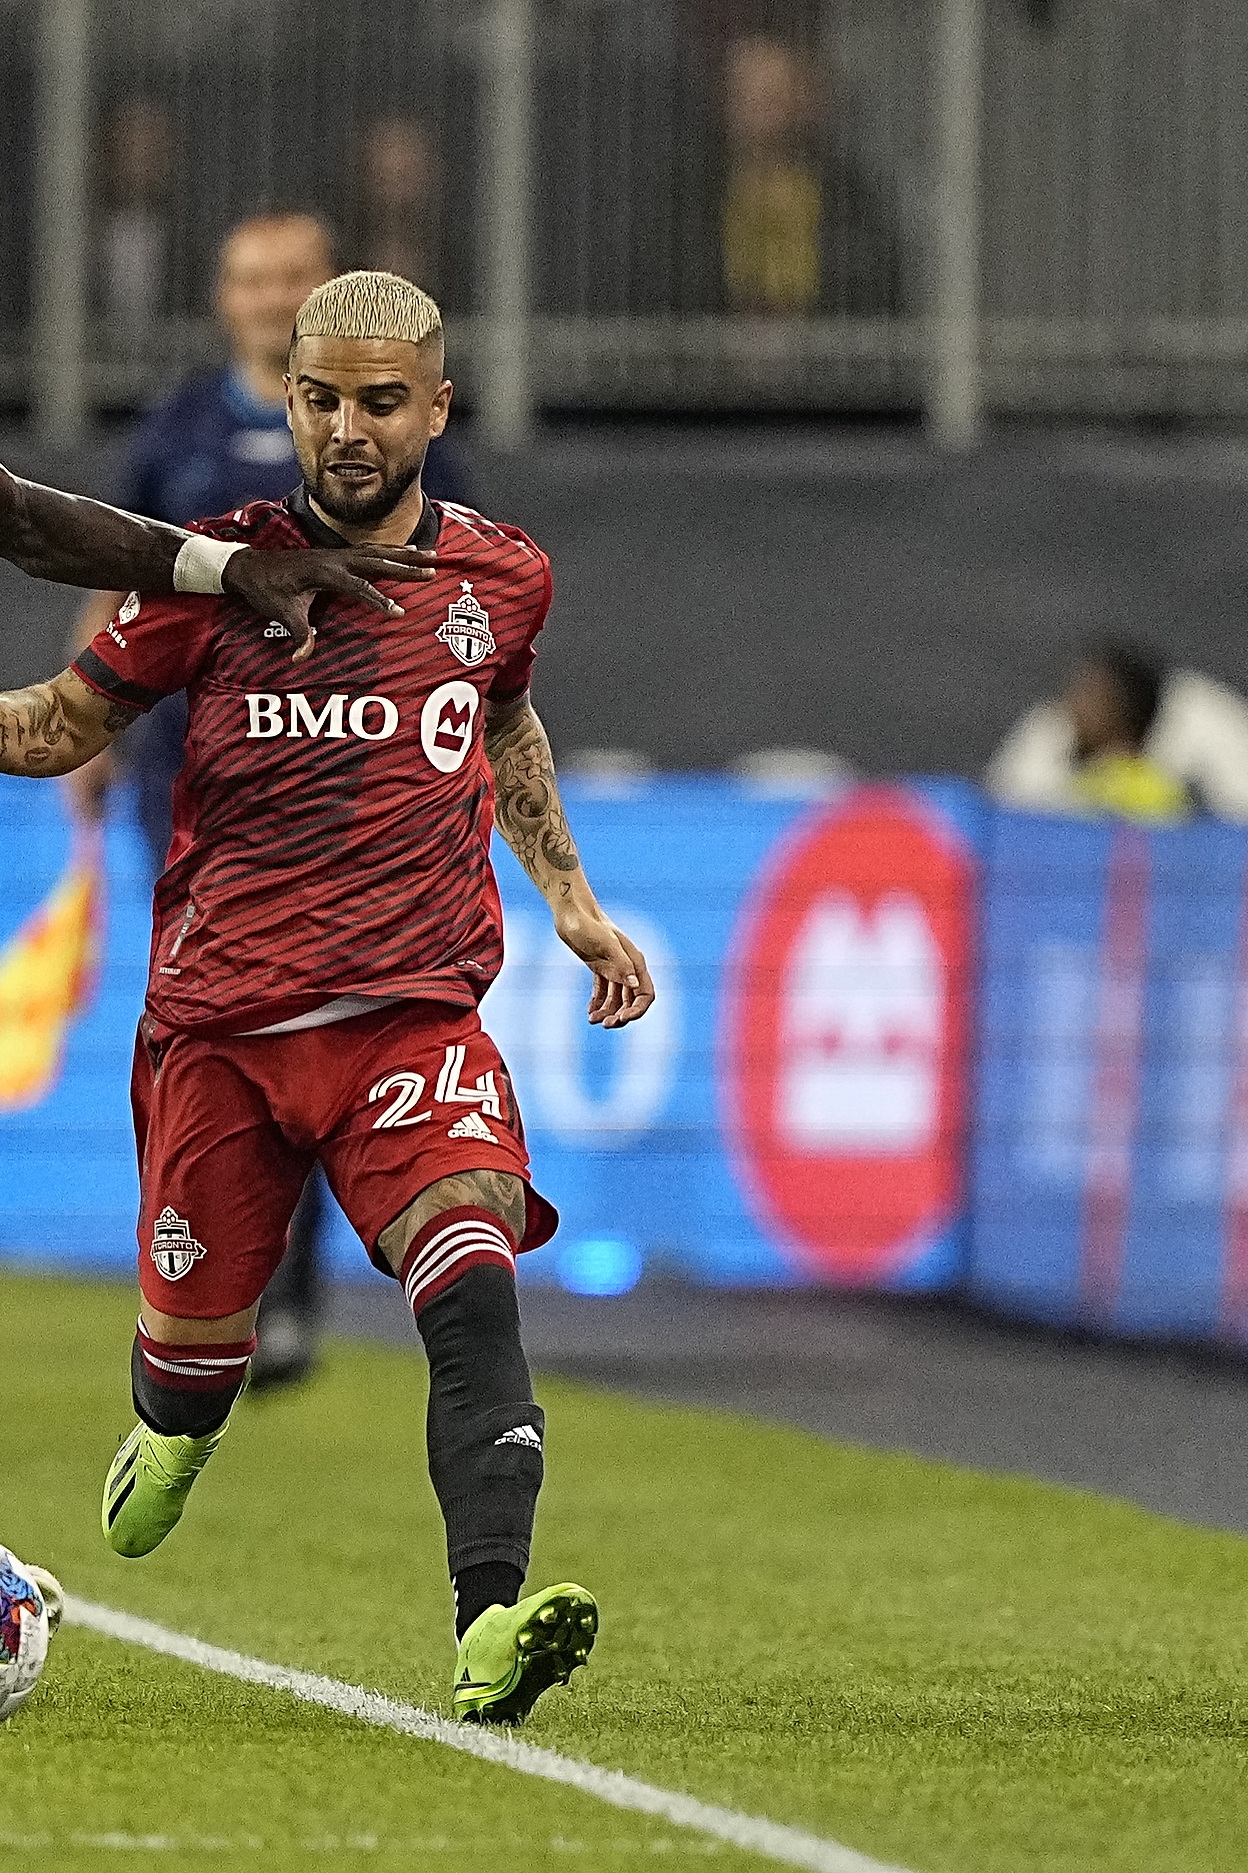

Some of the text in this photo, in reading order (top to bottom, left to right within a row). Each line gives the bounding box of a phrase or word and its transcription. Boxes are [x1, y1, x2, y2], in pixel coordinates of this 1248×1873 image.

[446, 625, 490, 641] TORONTO
[245, 693, 399, 740] BMO
[368, 1044, 502, 1129] 24
[447, 1127, 499, 1145] adidas
[154, 1240, 193, 1251] TORONTO
